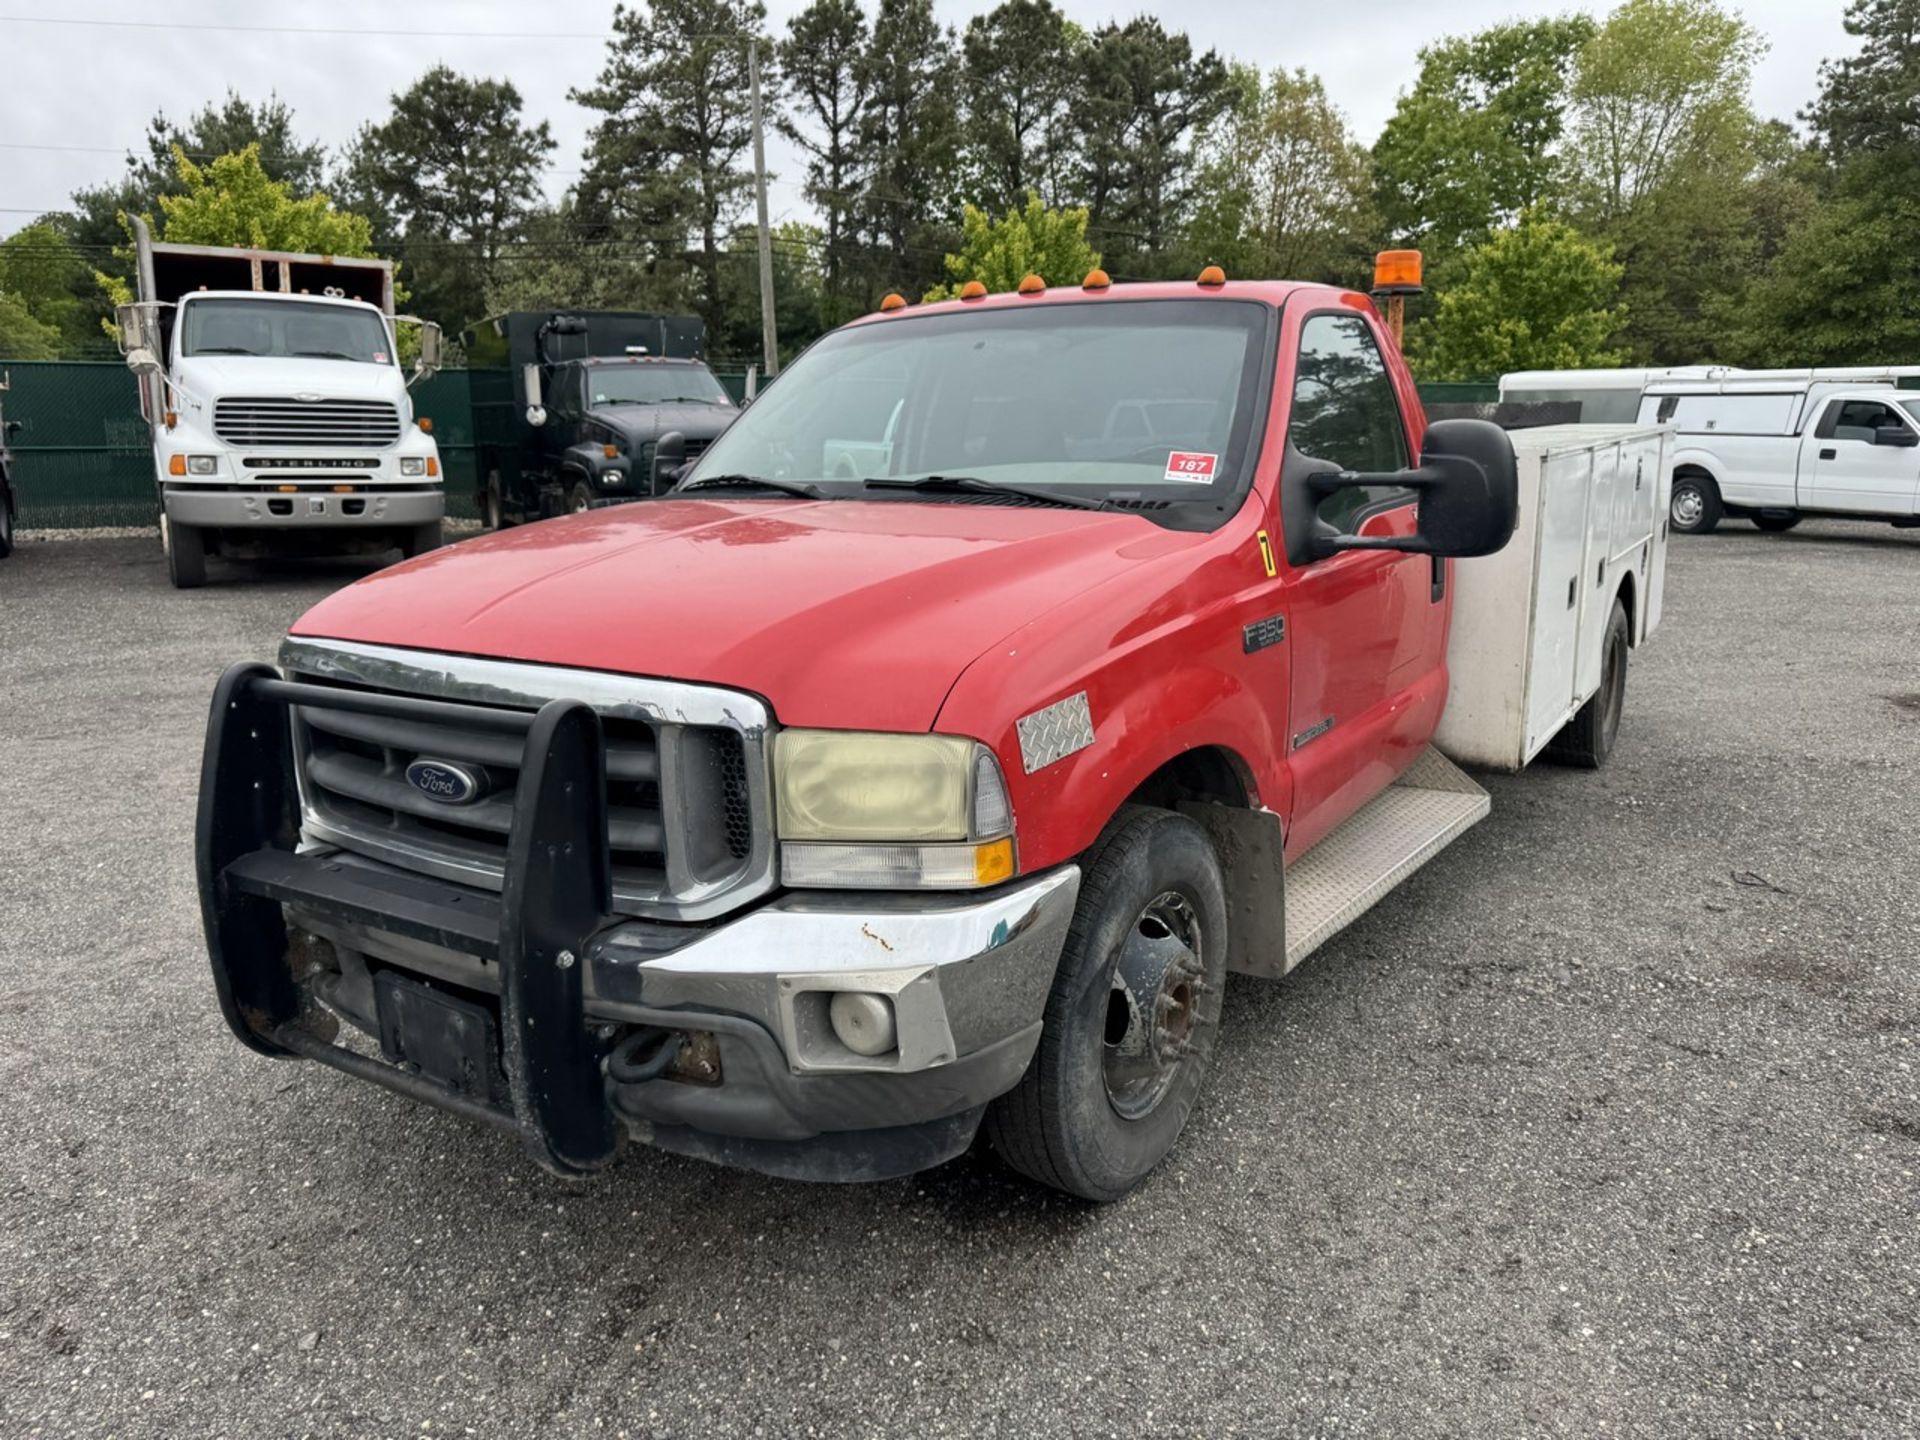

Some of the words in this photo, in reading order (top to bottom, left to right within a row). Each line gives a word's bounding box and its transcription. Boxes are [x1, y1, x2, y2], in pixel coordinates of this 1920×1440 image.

[260, 459, 365, 468] STERLING
[1178, 460, 1207, 472] 187
[420, 768, 456, 794] Ford
